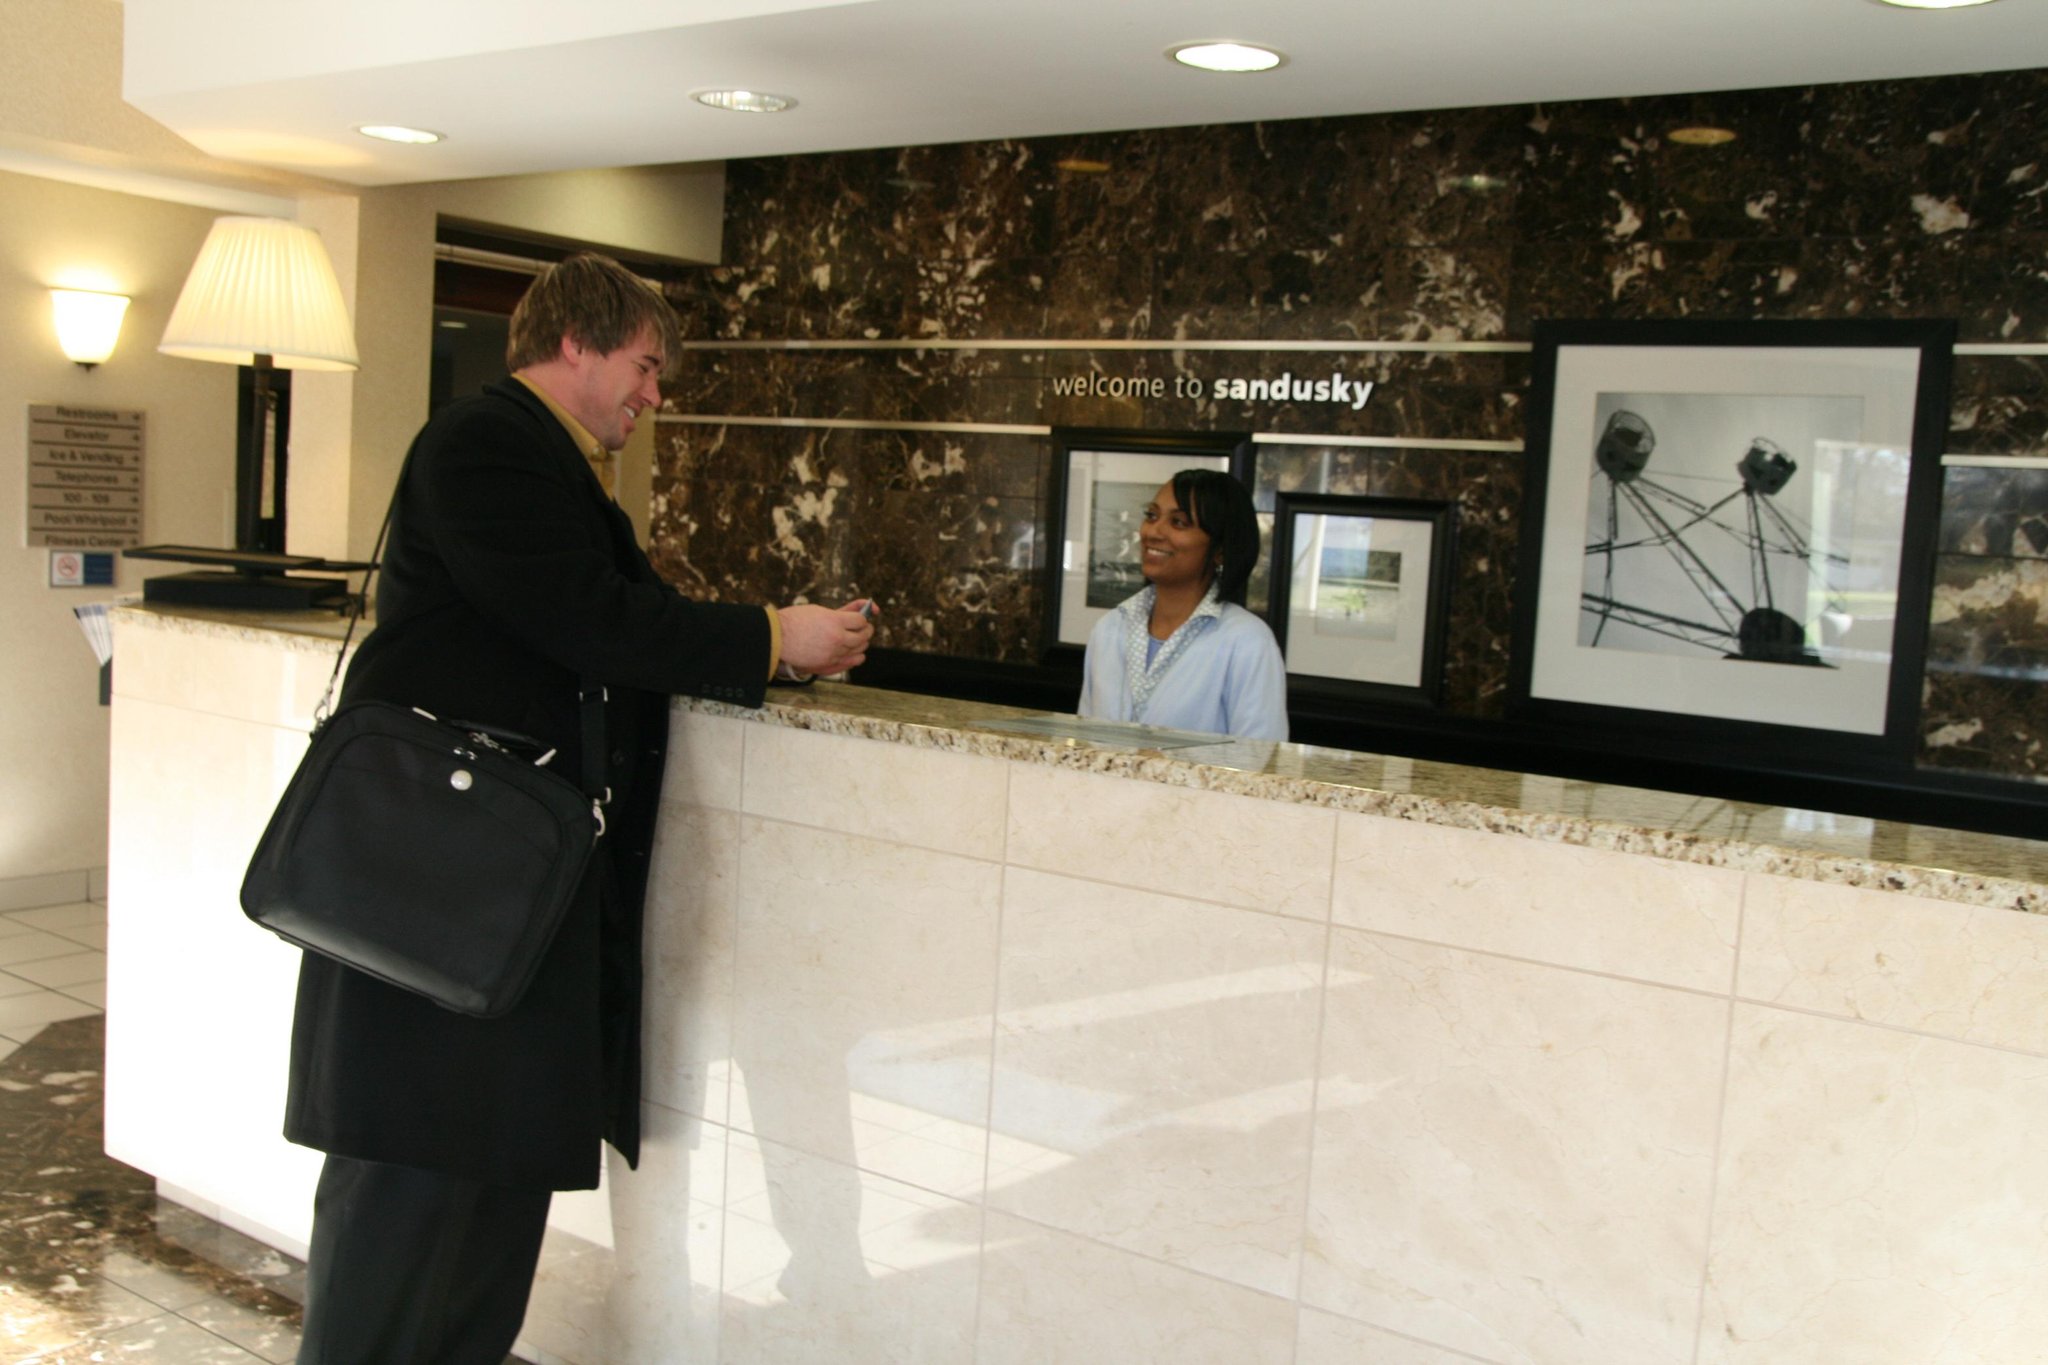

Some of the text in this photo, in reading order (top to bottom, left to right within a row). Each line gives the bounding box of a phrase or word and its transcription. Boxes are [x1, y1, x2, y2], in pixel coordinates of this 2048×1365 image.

[1053, 372, 1373, 411] welcome to sandusky
[56, 406, 118, 420] Restrooms
[64, 428, 109, 440] Elevator
[80, 451, 123, 464] Vending
[55, 470, 118, 484] Telephones
[45, 535, 124, 547] Fitness Center
